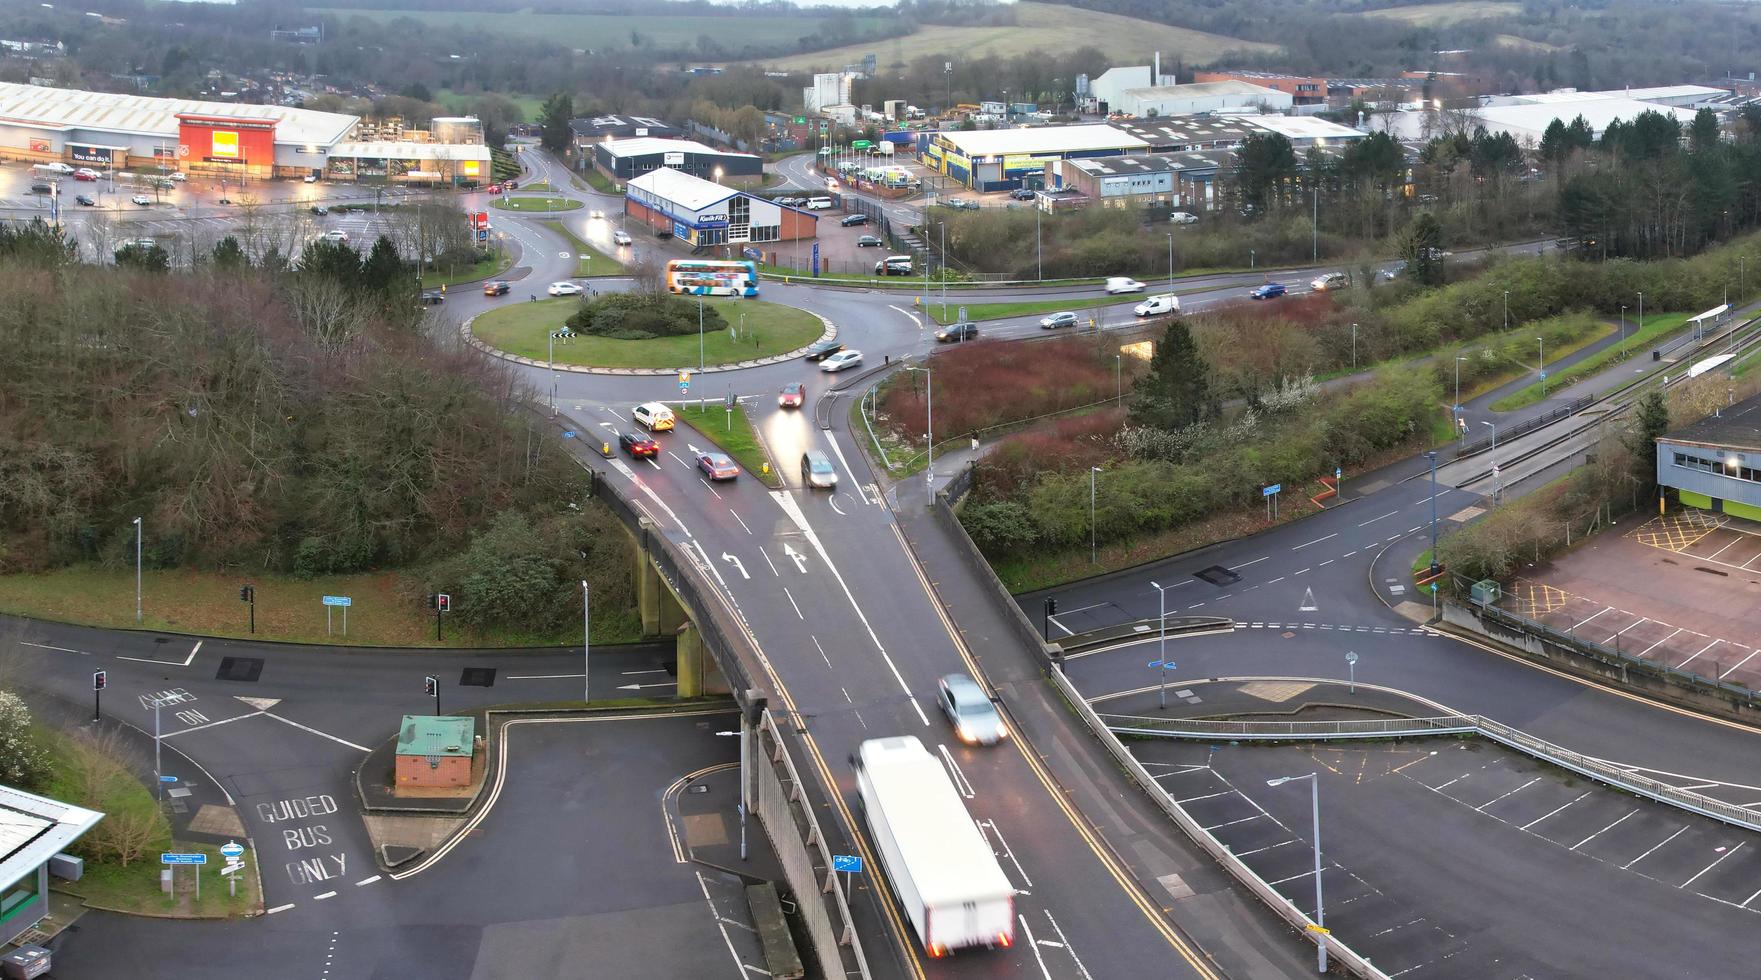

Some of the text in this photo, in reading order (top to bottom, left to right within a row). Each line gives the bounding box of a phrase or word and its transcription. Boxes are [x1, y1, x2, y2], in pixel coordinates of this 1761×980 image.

[175, 708, 211, 726] NO
[256, 794, 338, 824] GUIDED
[283, 825, 332, 850] BUS
[286, 853, 345, 885] ONLY
